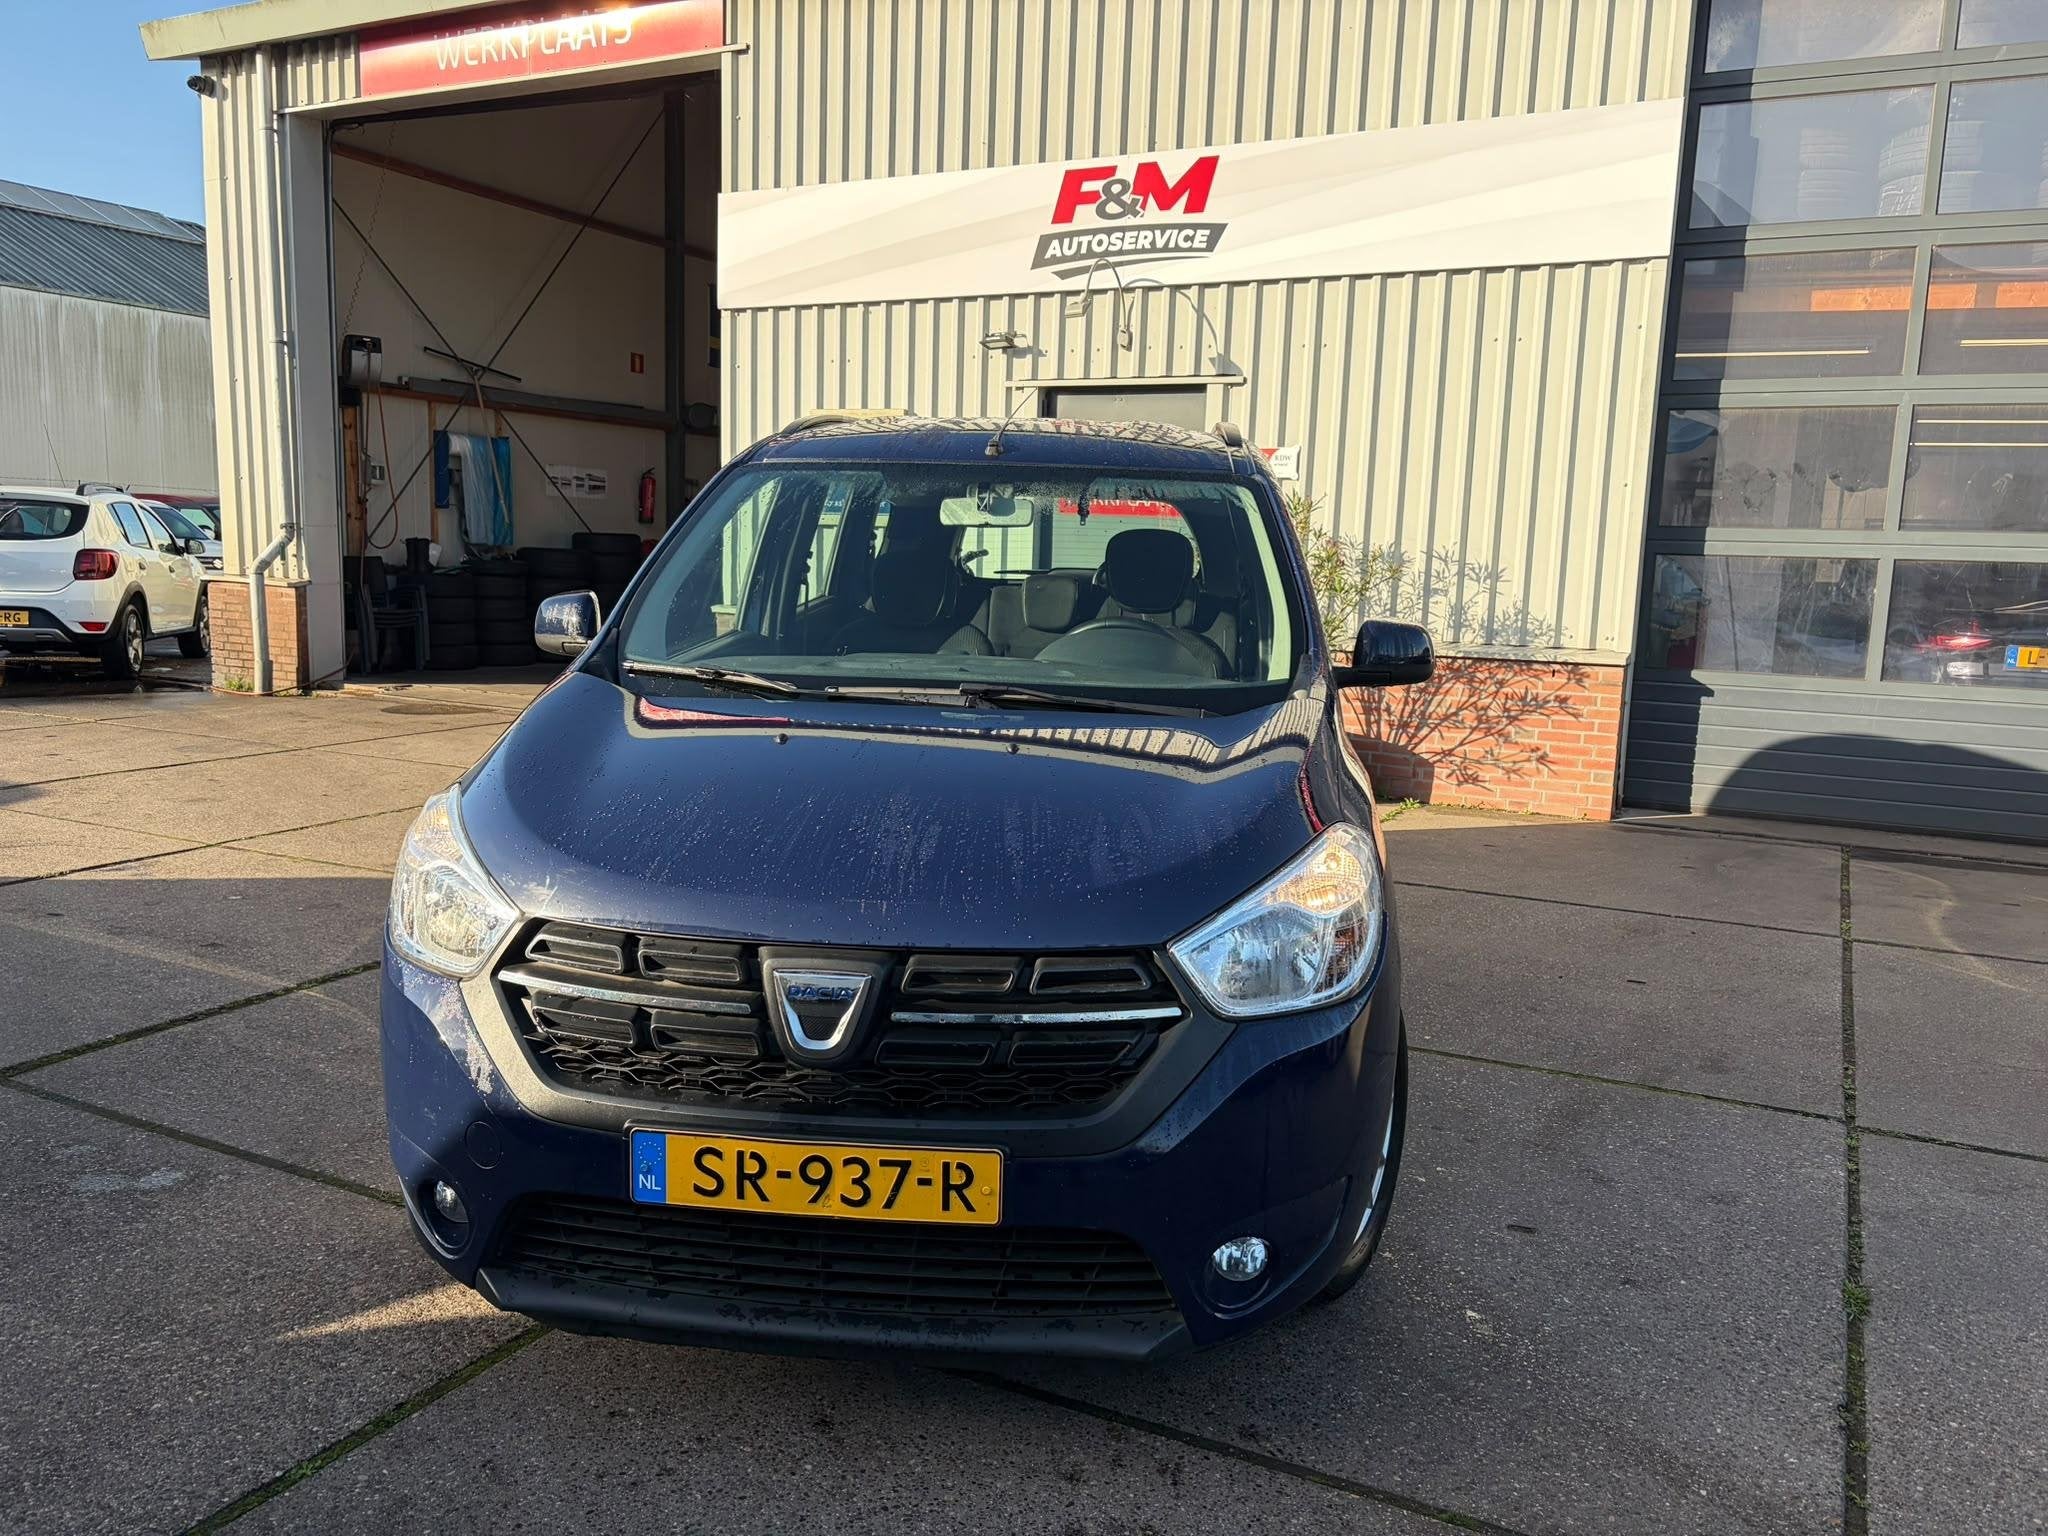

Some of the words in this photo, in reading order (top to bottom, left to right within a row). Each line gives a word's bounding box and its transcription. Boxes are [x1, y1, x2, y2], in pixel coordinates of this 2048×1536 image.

[1051, 155, 1220, 224] F&M
[1044, 229, 1210, 259] AUTOSERVICE
[788, 986, 853, 1000] DACIA
[639, 1173, 661, 1190] NL
[693, 1146, 976, 1213] SR-937-R
